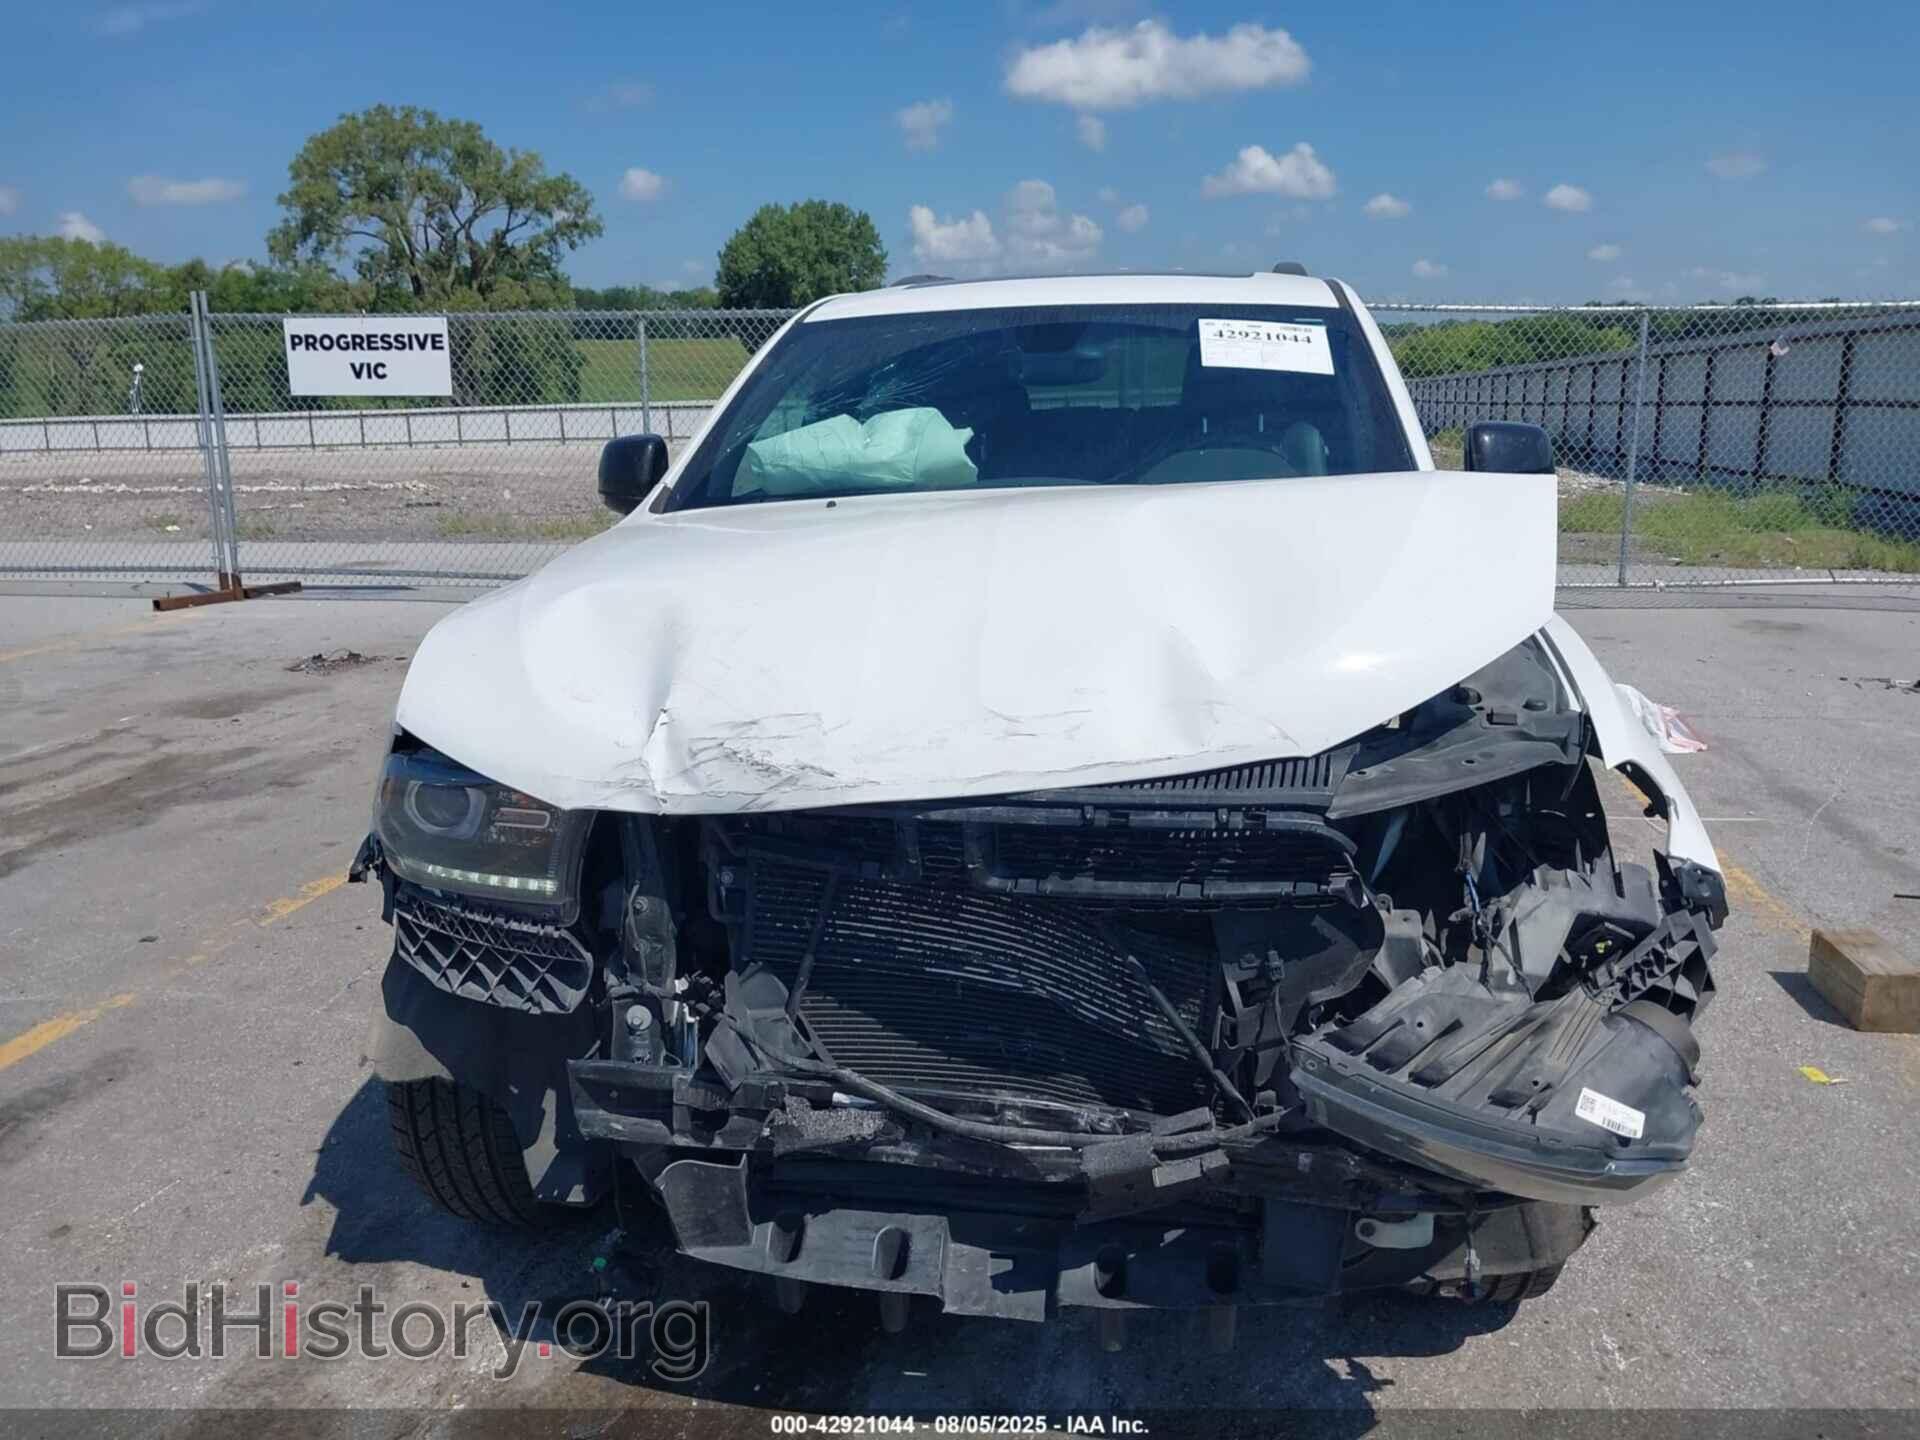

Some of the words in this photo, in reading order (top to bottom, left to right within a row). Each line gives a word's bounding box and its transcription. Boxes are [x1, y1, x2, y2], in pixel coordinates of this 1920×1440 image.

[290, 333, 444, 351] PROGRESSIVE
[1213, 329, 1313, 344] 42921044
[350, 362, 387, 379] VIC
